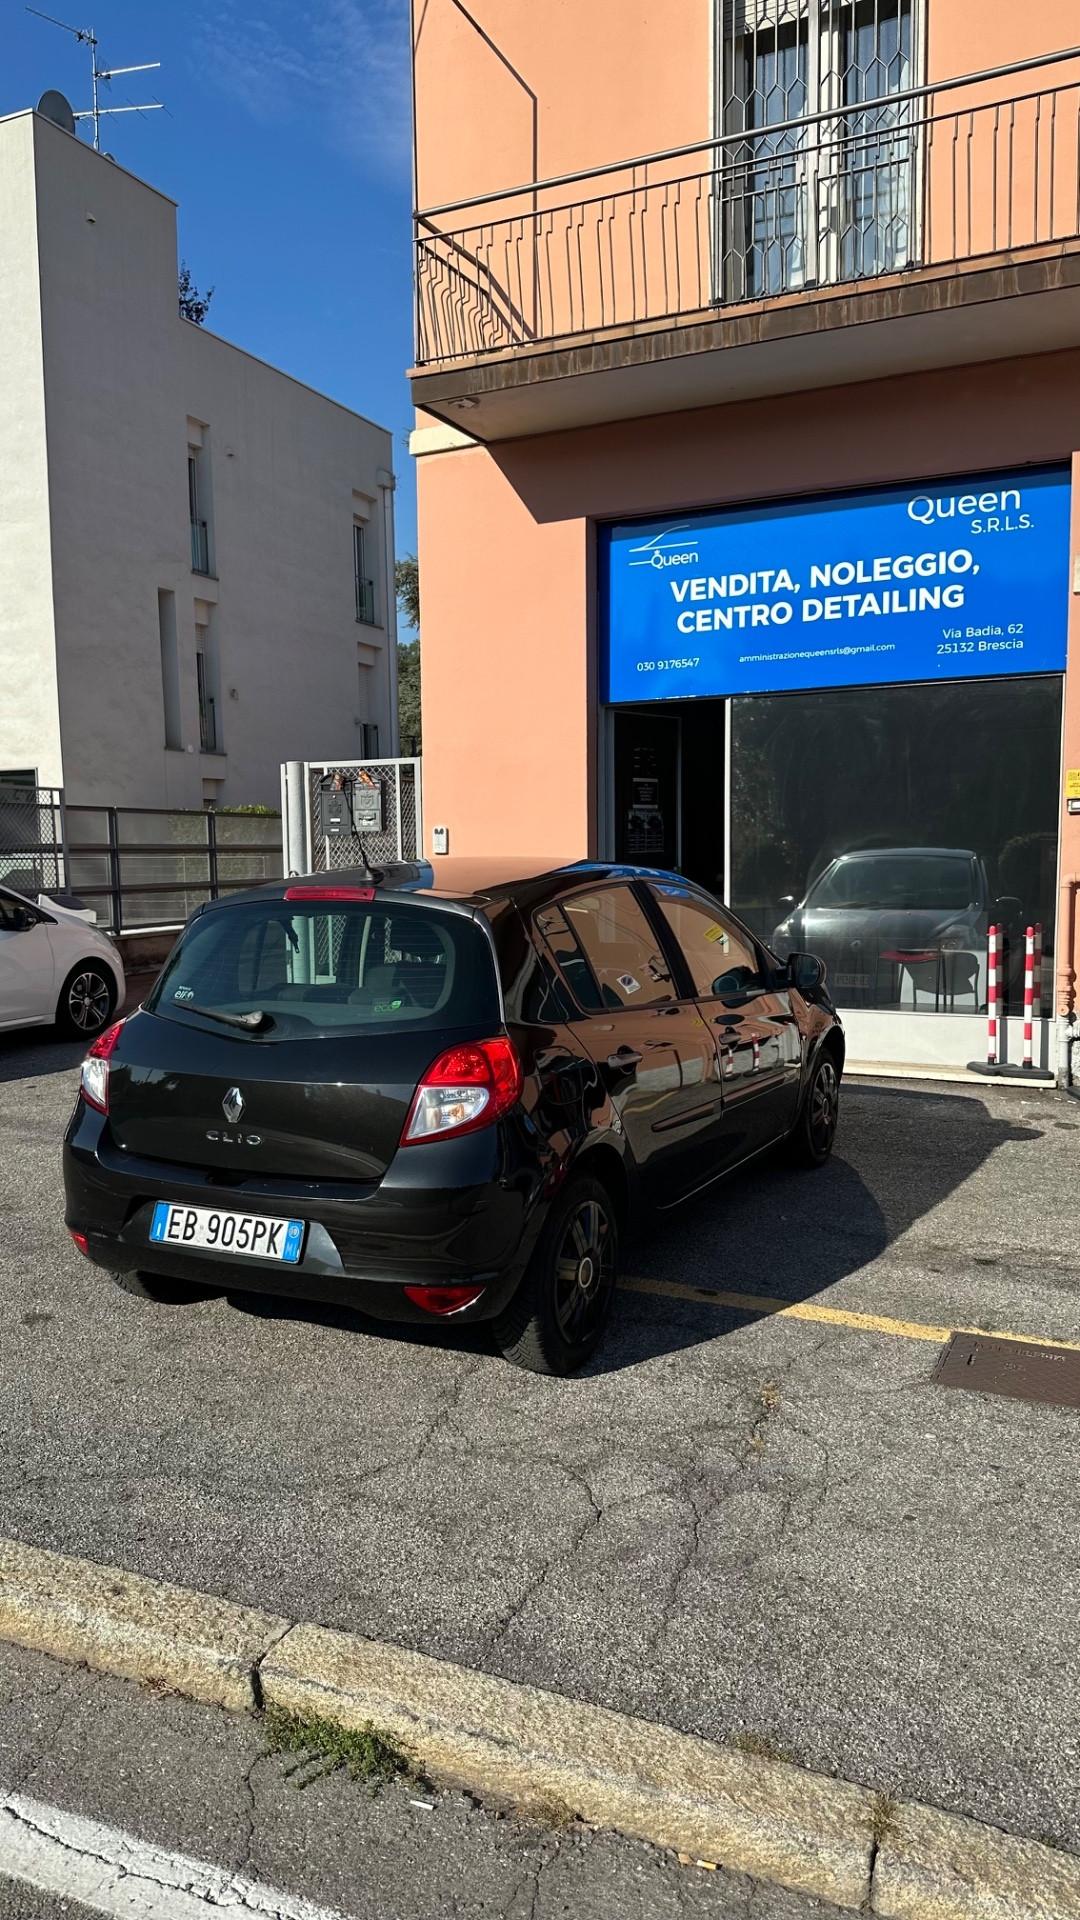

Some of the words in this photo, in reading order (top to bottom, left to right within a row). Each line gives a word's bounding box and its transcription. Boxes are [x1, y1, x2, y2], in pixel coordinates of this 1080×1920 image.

[908, 489, 1020, 525] Queen
[971, 514, 1035, 534] S.R.L.S.
[651, 551, 699, 570] Queen
[670, 569, 800, 602] VENDITA,
[810, 549, 980, 588] NOLEGGIO,
[677, 601, 793, 633] CENTRO
[802, 584, 965, 622] DETAILING
[943, 628, 962, 639] Via
[966, 625, 1004, 637] Badia,
[1008, 623, 1024, 634] 62
[739, 643, 896, 663] amministrazionequeensrls@gmail.com
[937, 642, 974, 655] 25132
[978, 638, 1024, 651] Brescia
[637, 661, 655, 672] 030
[657, 657, 700, 670] 9176547
[206, 1130, 261, 1145] CLIO
[168, 1208, 198, 1241] EB
[206, 1214, 284, 1255] 905PK
